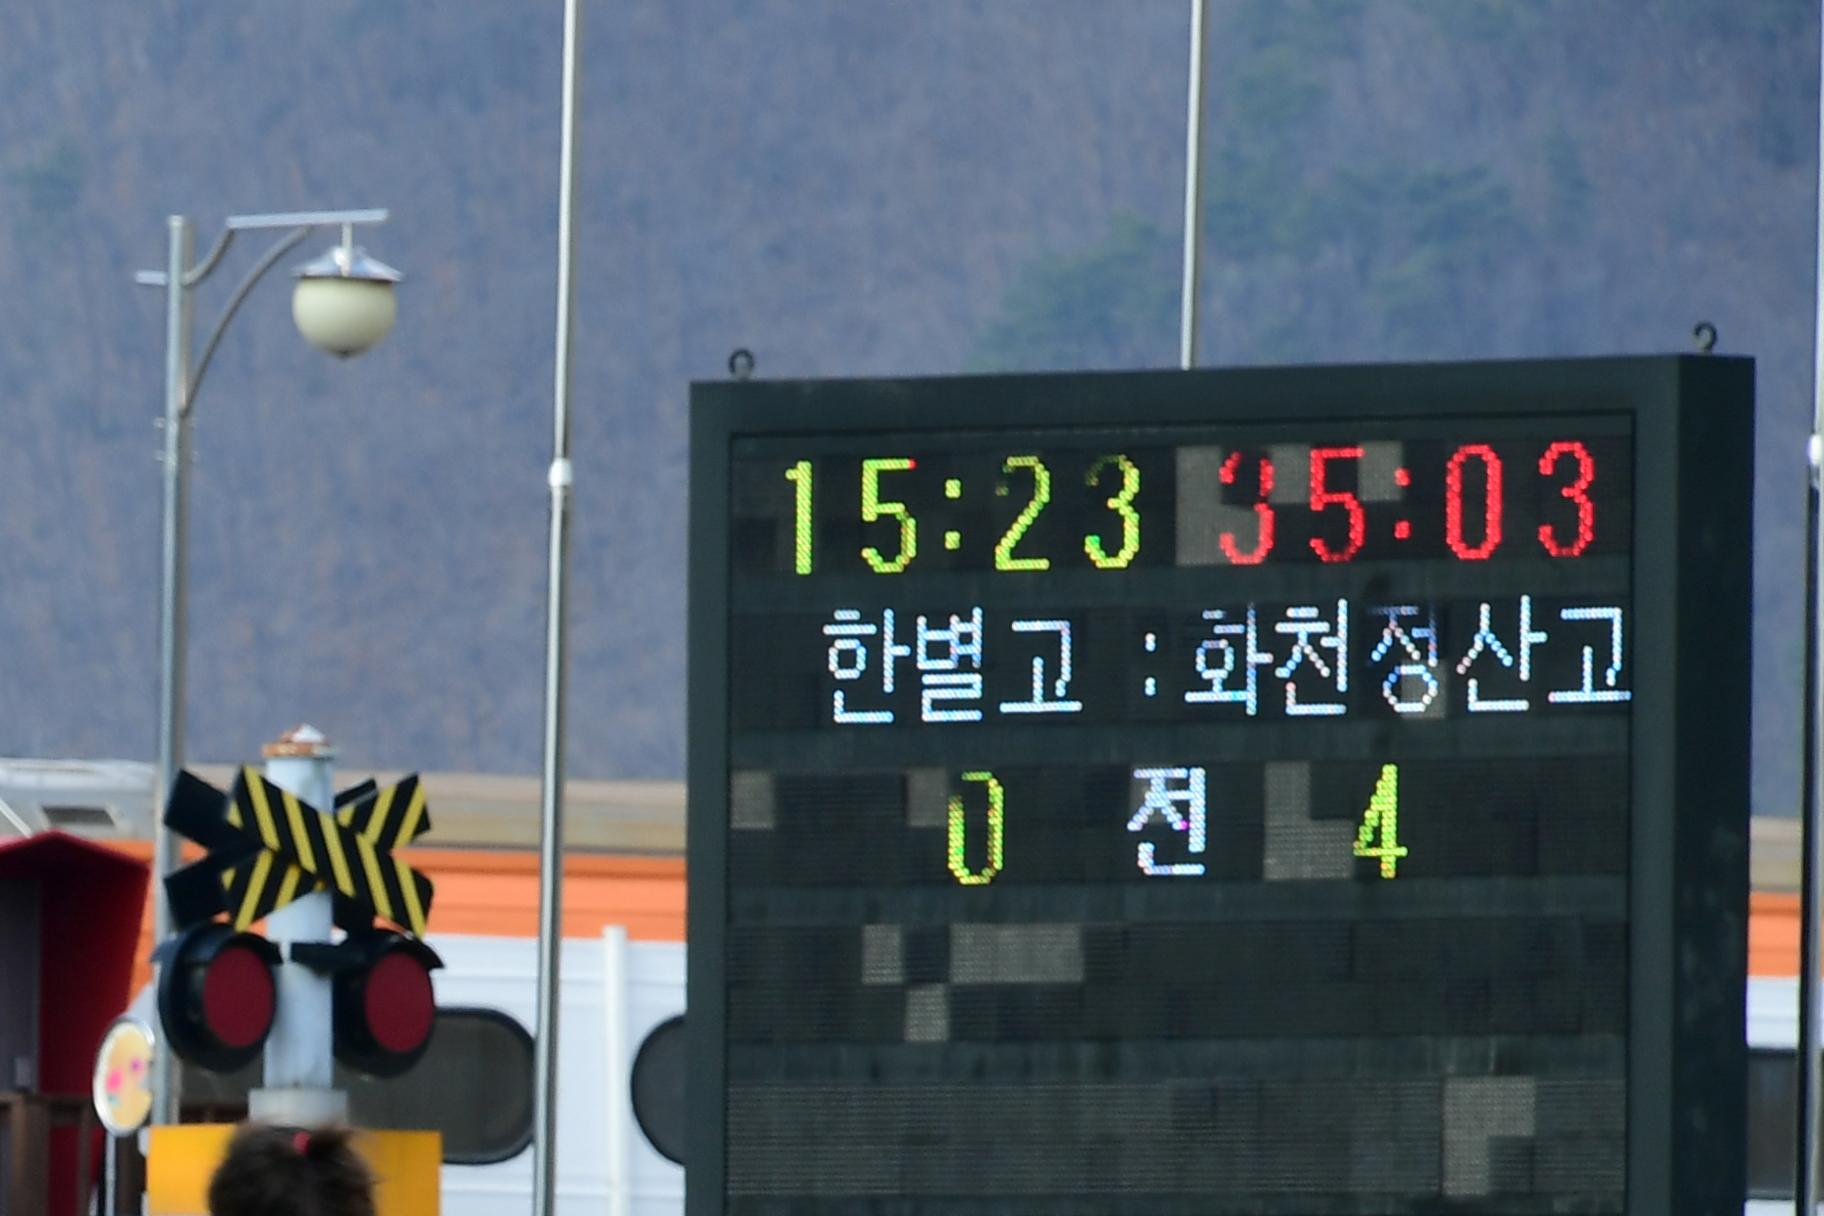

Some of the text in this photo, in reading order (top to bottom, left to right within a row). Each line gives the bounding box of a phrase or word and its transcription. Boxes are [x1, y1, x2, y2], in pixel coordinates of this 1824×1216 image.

[786, 441, 1595, 575] 15:23 35:03
[823, 607, 1082, 723] 한별고
[1184, 594, 1633, 716] 화천정산고
[948, 764, 1408, 885] 0 전 4
